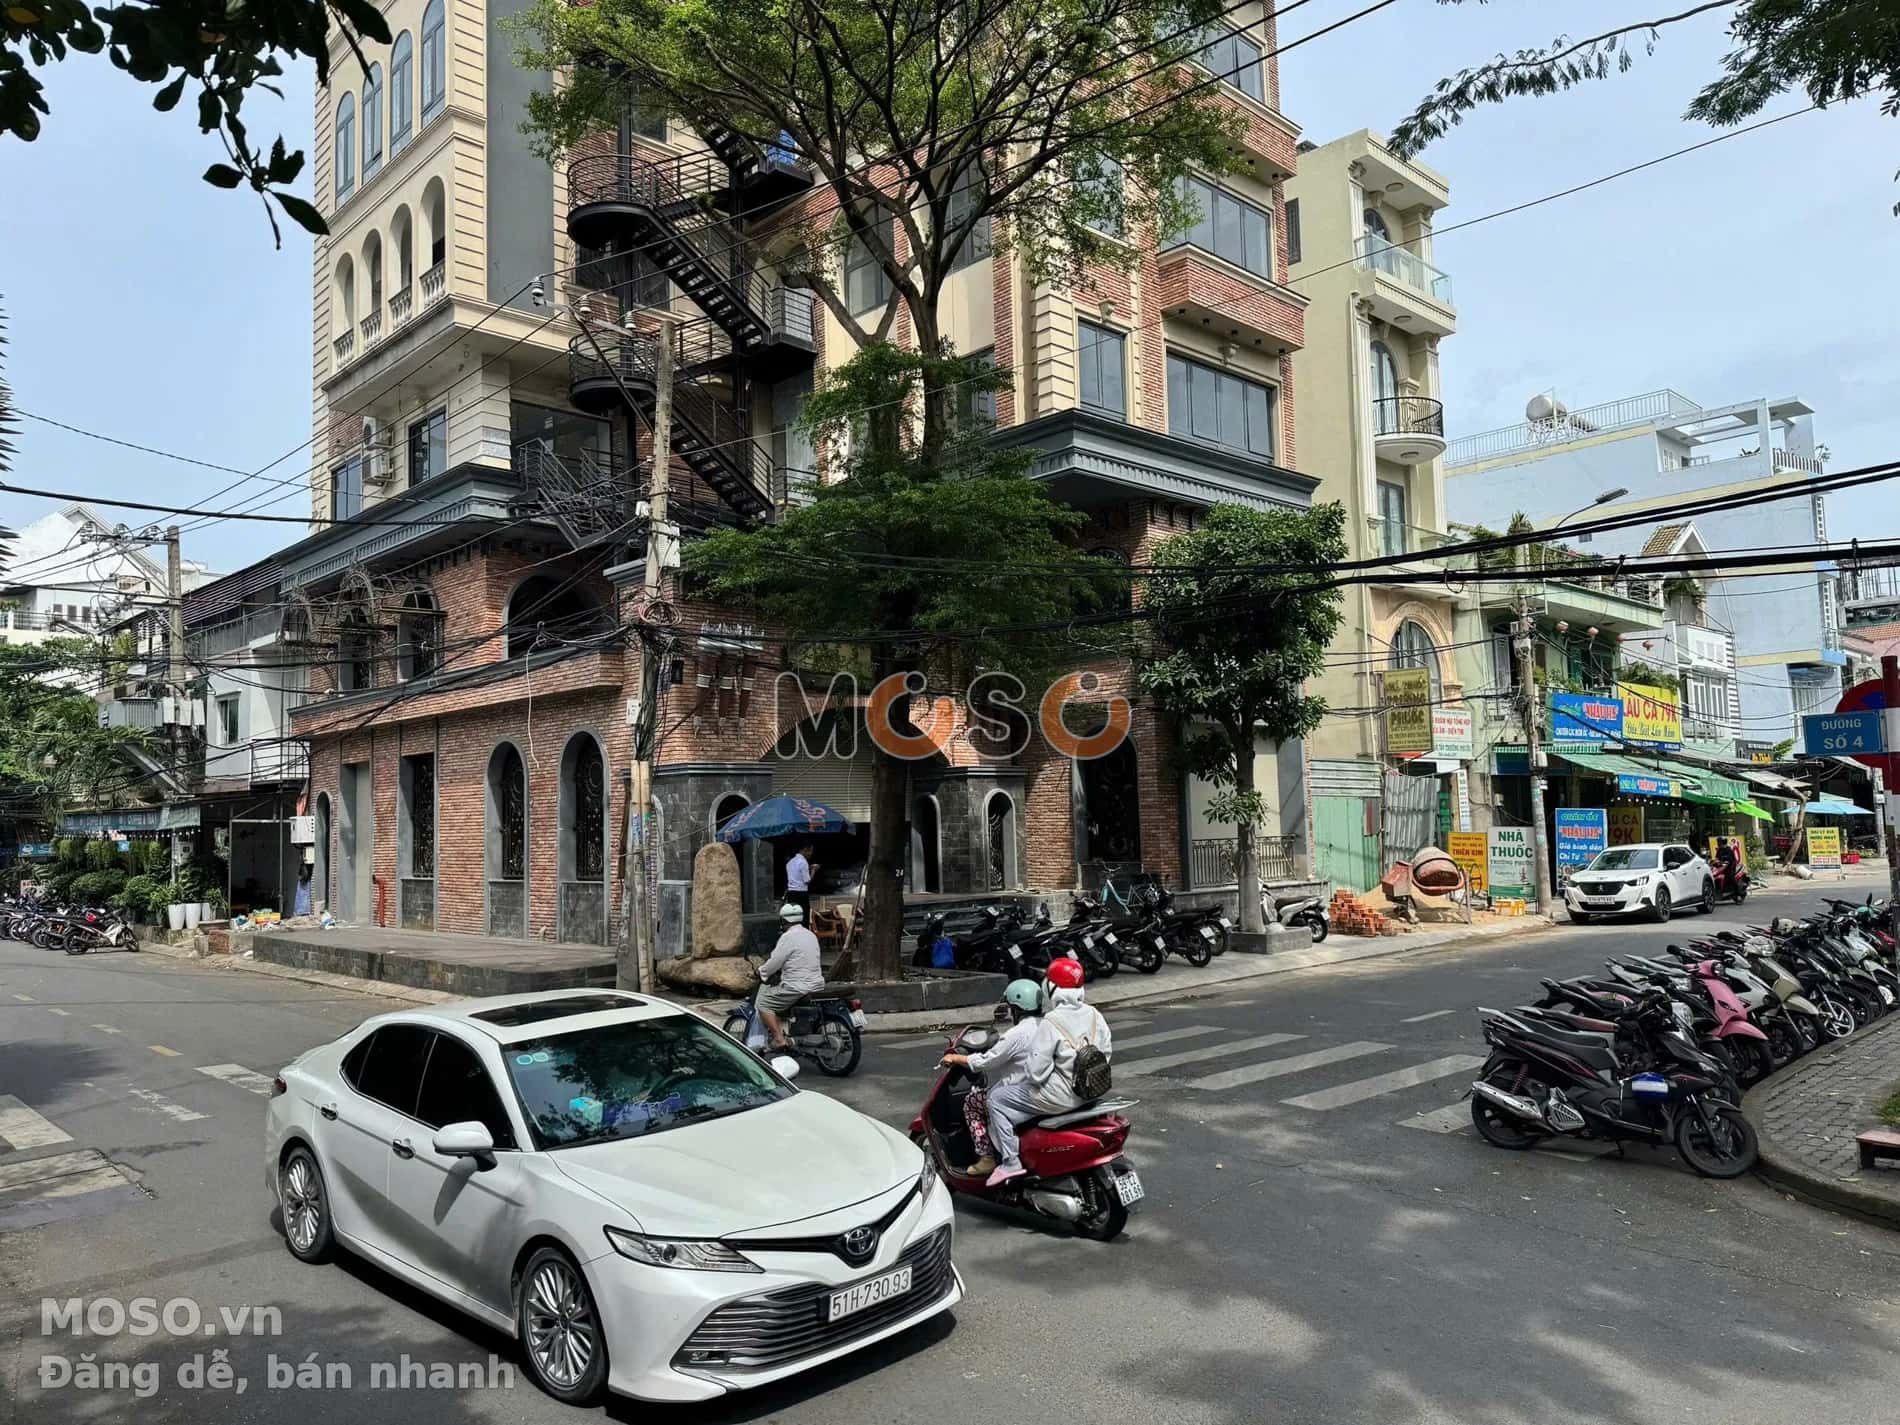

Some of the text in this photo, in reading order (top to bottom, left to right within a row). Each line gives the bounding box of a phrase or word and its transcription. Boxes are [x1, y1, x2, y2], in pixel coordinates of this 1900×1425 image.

[1823, 732, 1864, 750] SỐ 4
[1498, 828, 1524, 842] NHÀ
[1490, 844, 1533, 858] THUỐC
[832, 1270, 910, 1317] 51H-730.93
